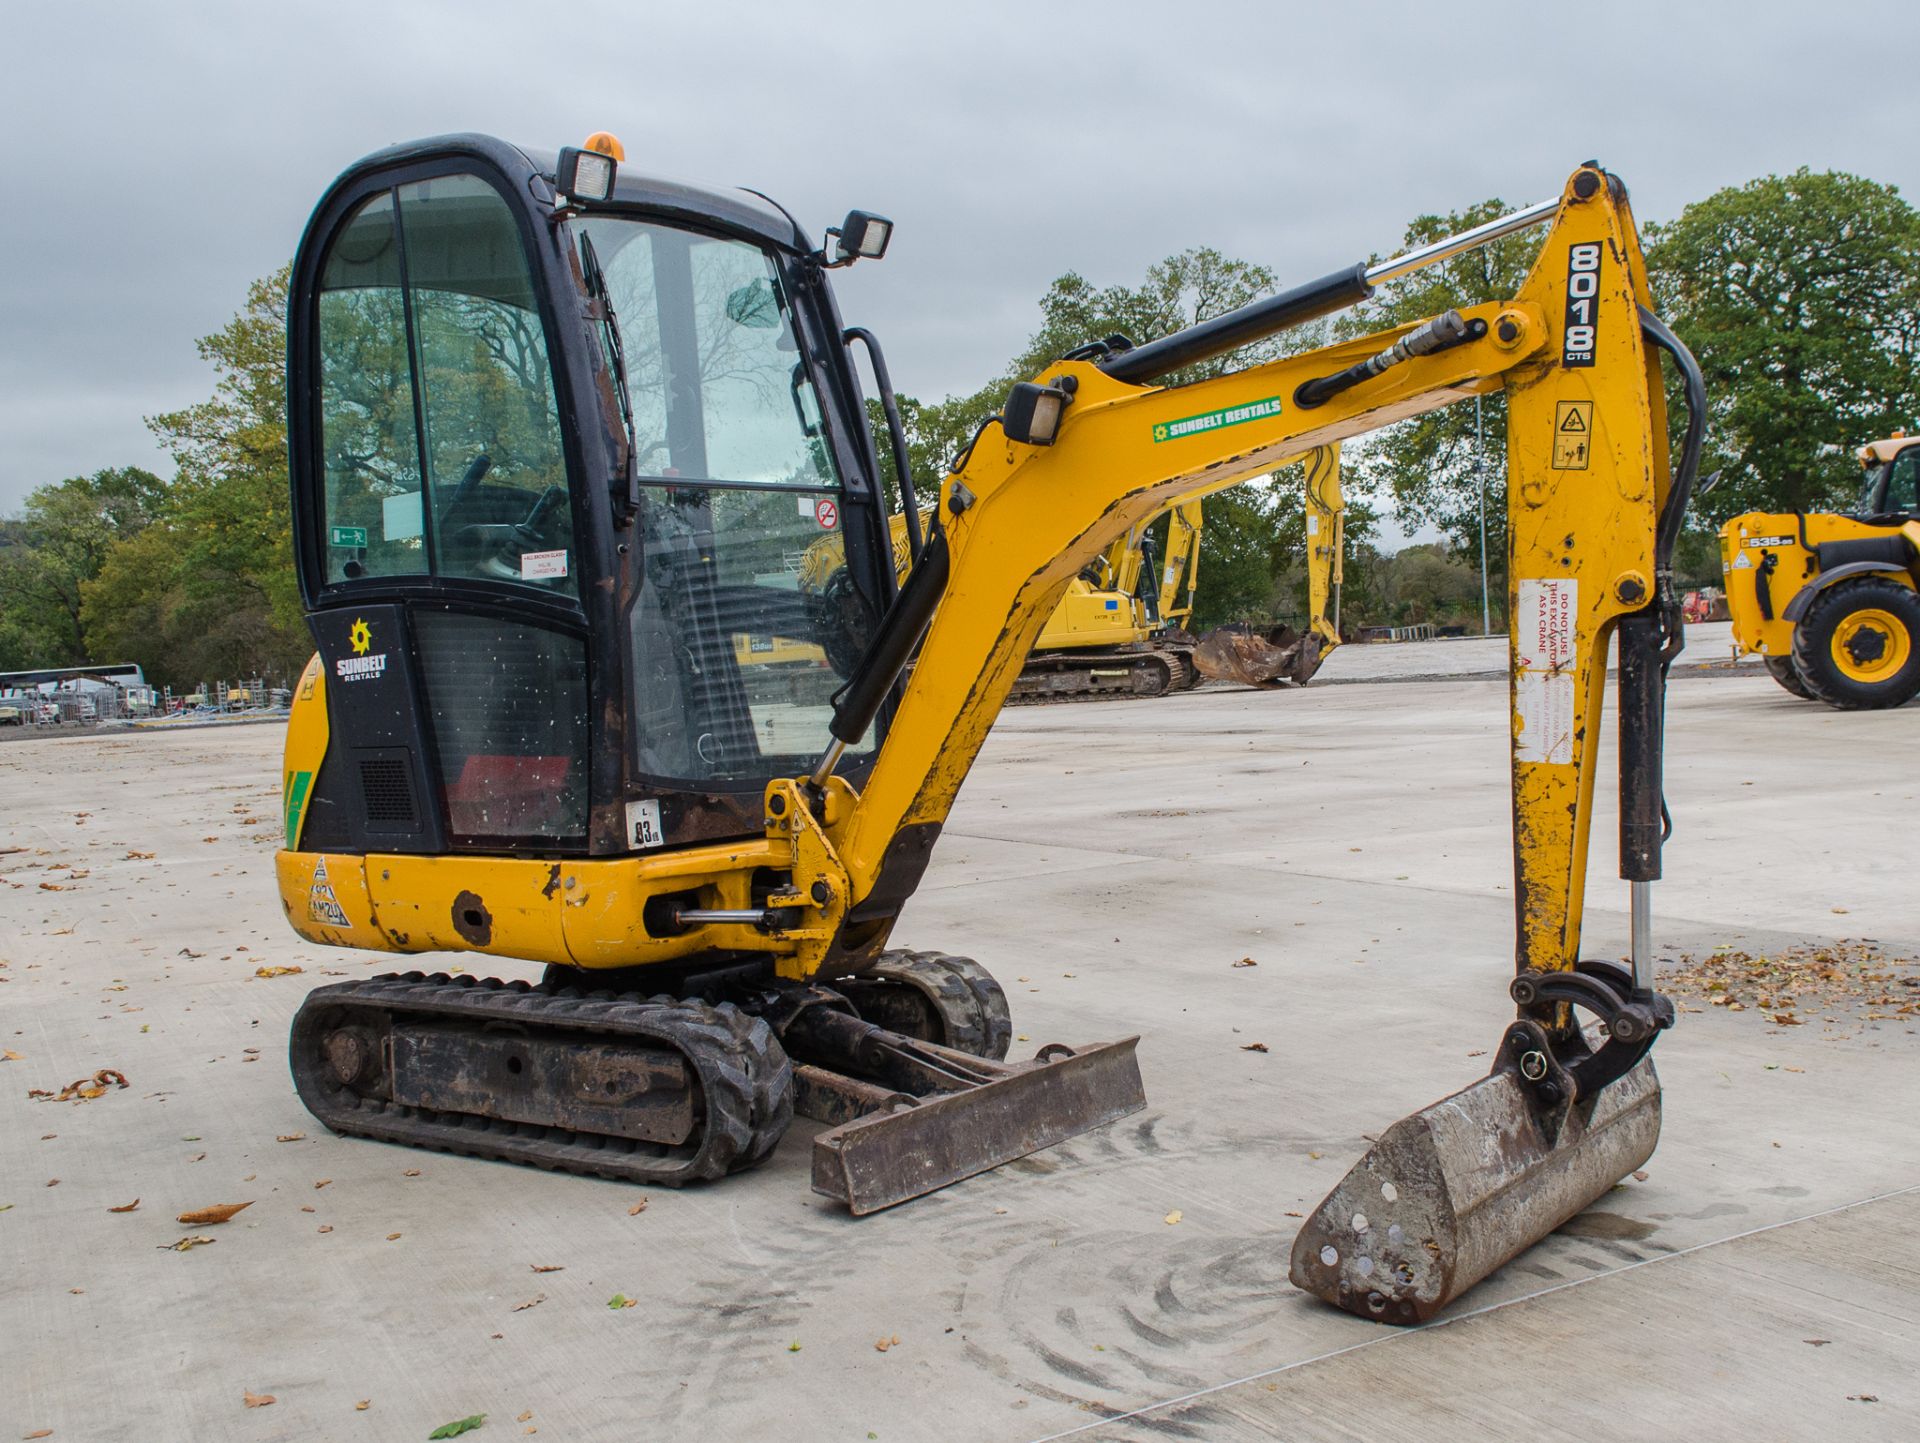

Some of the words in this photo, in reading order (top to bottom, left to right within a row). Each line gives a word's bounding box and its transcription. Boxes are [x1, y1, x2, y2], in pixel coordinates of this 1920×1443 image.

[1565, 245, 1599, 351] 8018
[1566, 352, 1591, 361] CTS
[1169, 413, 1223, 436] SUNBELT
[1224, 399, 1281, 423] RENTALS
[1538, 595, 1547, 608] AS
[1549, 582, 1558, 605] THIS
[1560, 593, 1568, 609] DO
[1560, 611, 1568, 634] NOT
[1538, 620, 1547, 654] CRANE
[1549, 607, 1558, 667] EXCAVATOR
[1560, 637, 1568, 655] USE
[336, 654, 387, 676] SUNBELT
[344, 671, 381, 682] RENTALS
